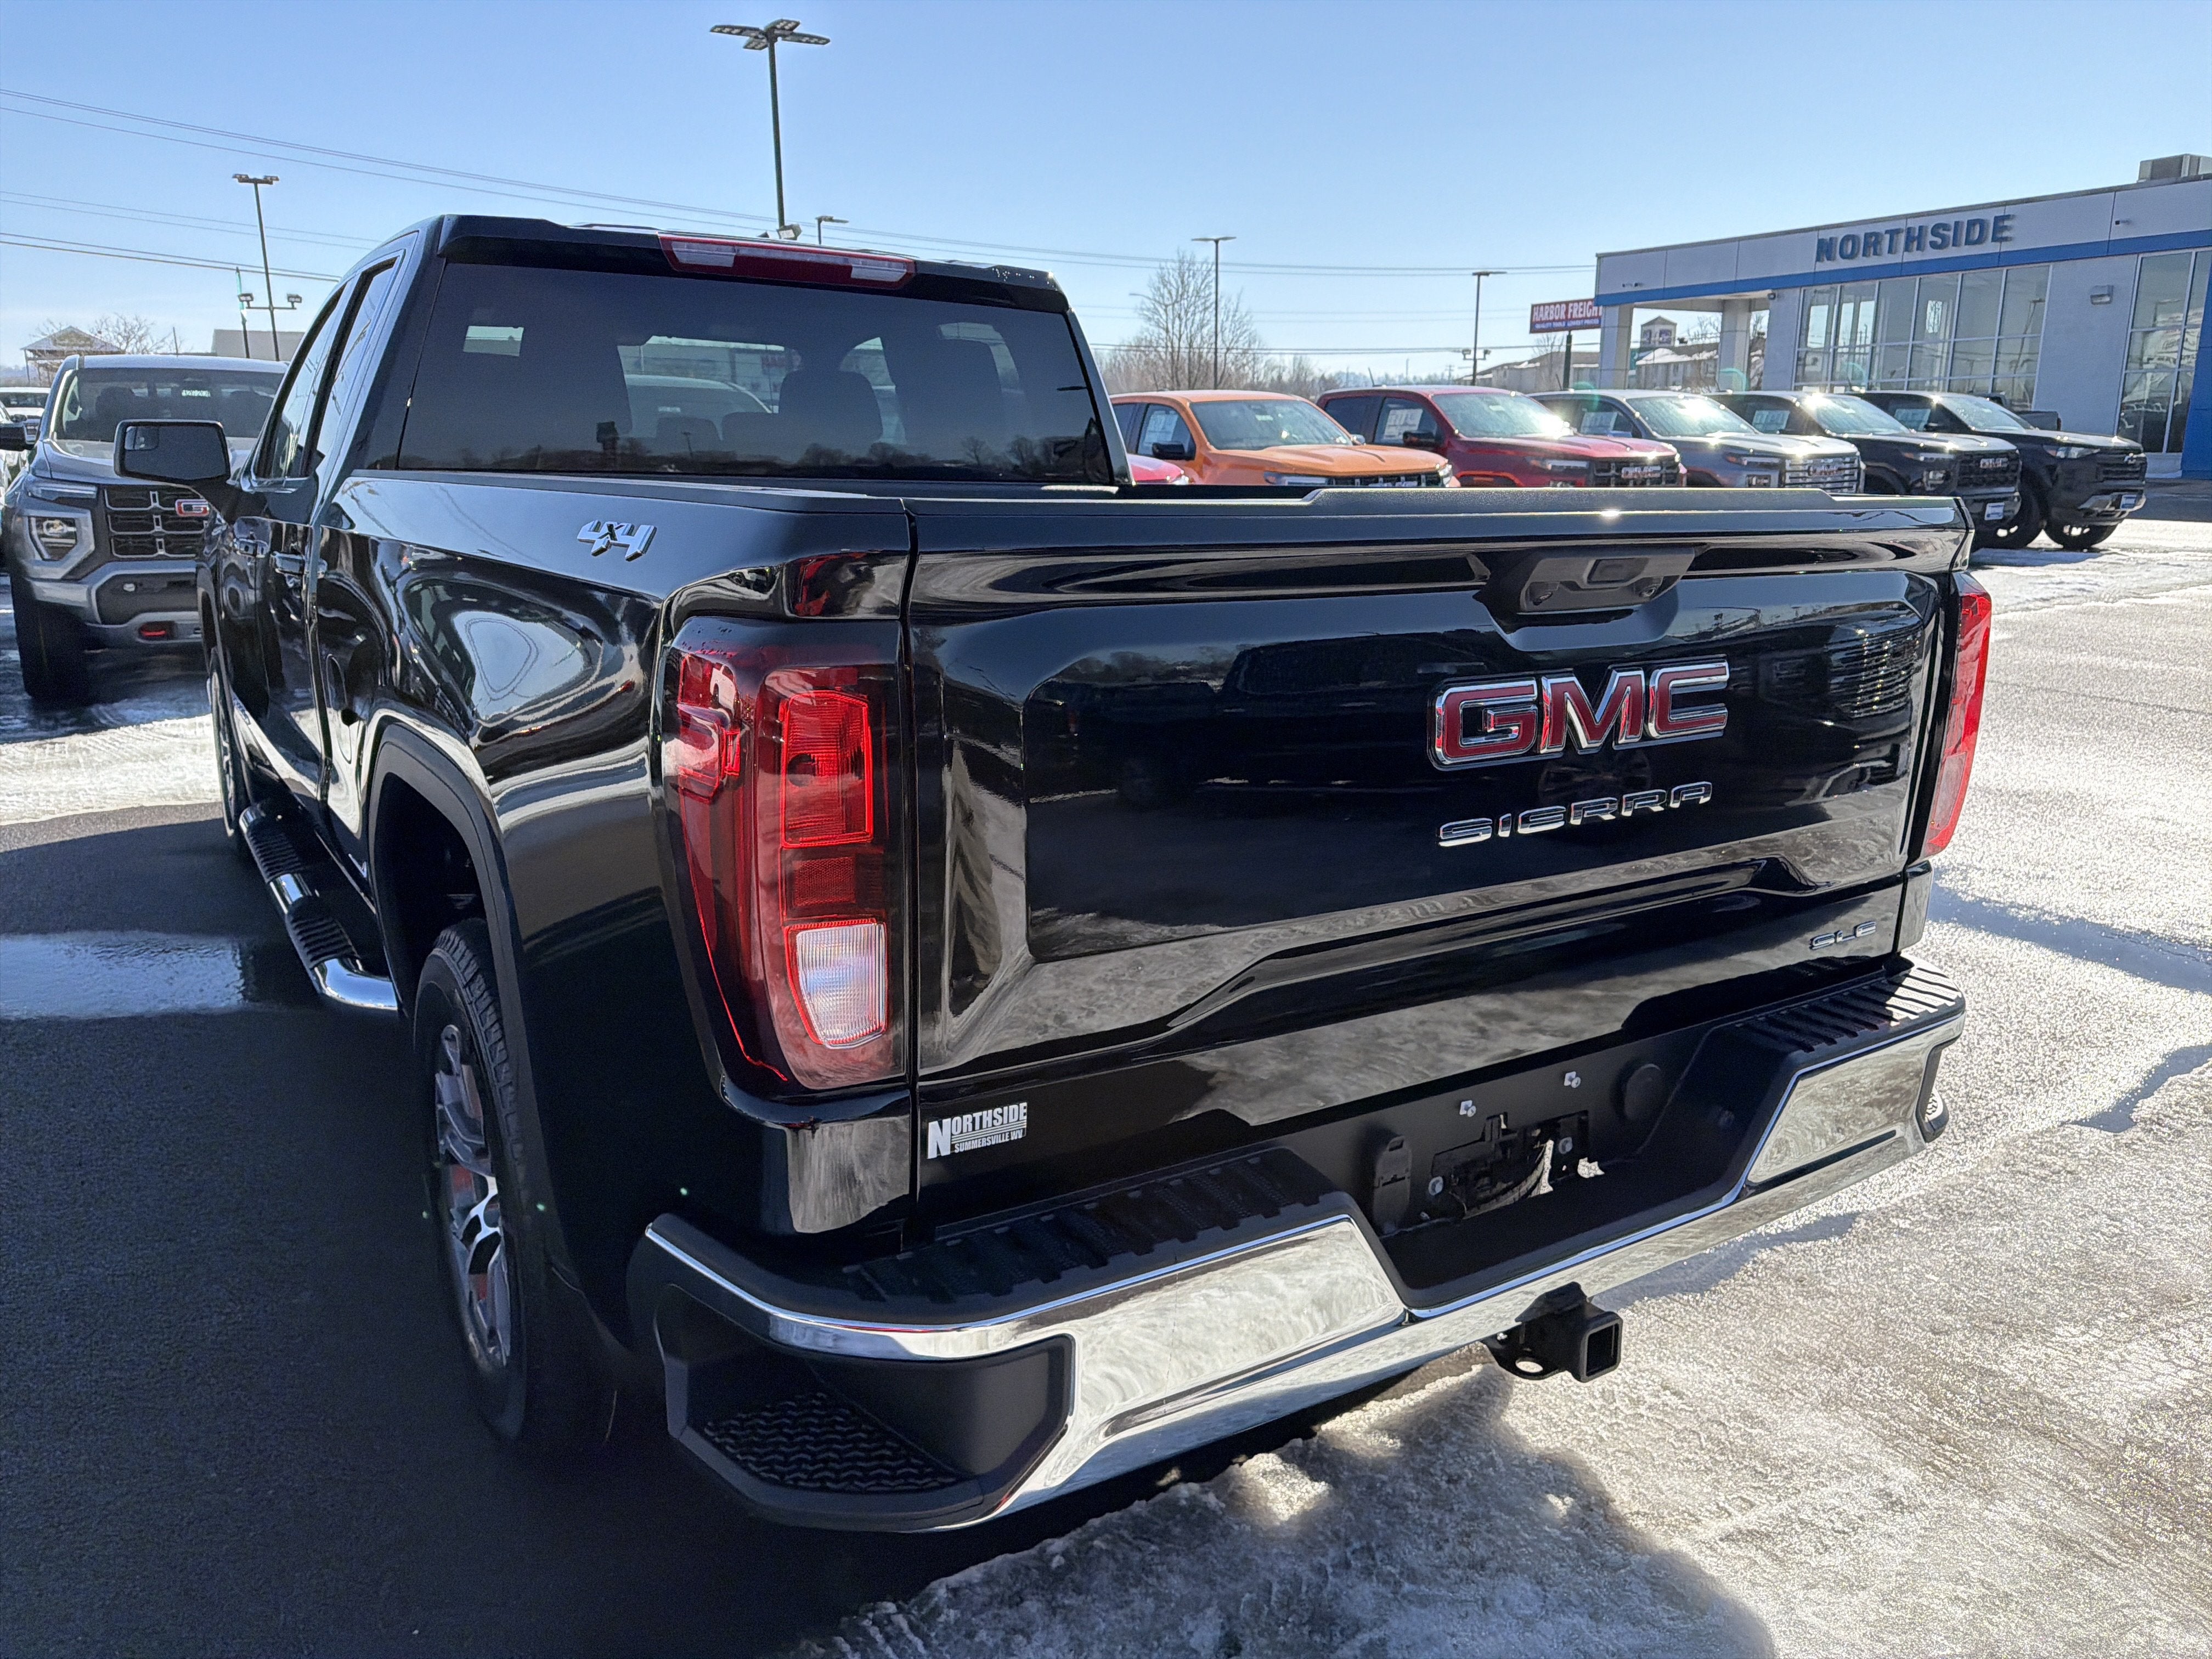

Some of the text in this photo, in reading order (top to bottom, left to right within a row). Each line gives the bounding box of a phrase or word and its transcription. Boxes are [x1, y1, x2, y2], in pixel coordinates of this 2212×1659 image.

[1815, 214, 2016, 262] NORTHSIDE
[1532, 303, 1566, 321] HARBOR
[1434, 658, 1730, 765] GMC
[1438, 781, 1712, 847] SIERRA
[1809, 920, 1877, 950] SLE
[927, 1102, 1027, 1159] NORTHSIDE
[954, 1129, 1023, 1153] SUMMERSVILLE WV
